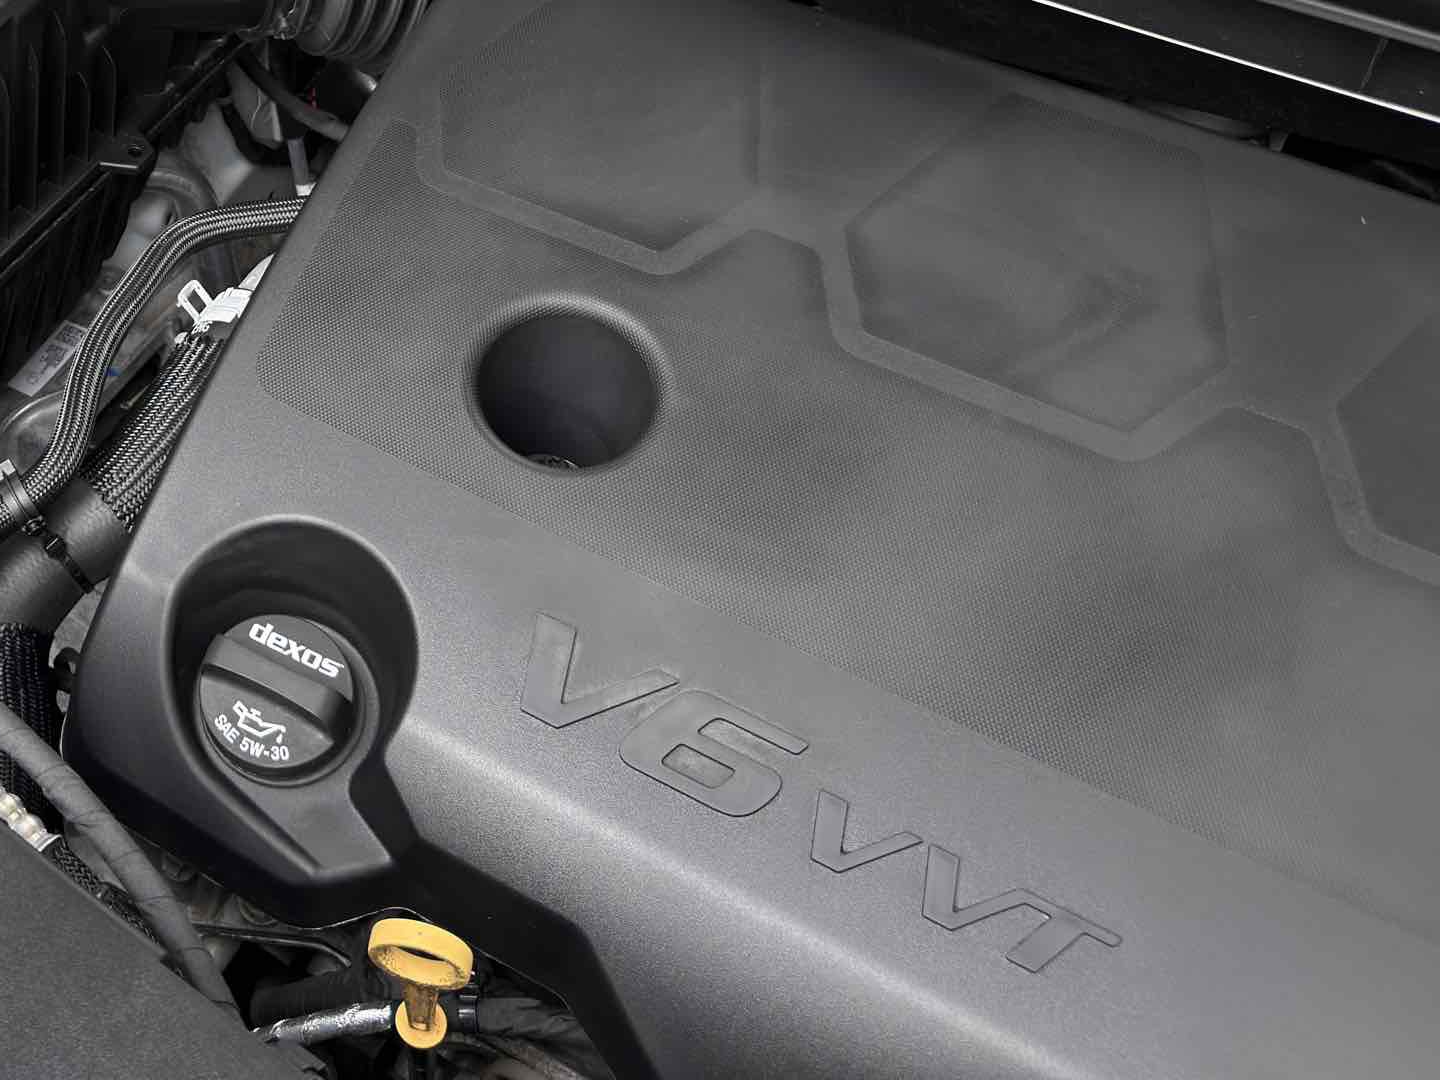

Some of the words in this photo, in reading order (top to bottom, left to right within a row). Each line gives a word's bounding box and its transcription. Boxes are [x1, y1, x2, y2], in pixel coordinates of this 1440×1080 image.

[249, 623, 344, 678] dexos
[214, 714, 240, 744] SAE
[239, 738, 290, 761] 5W-30
[520, 611, 809, 817] V6
[810, 788, 1123, 973] VVT
